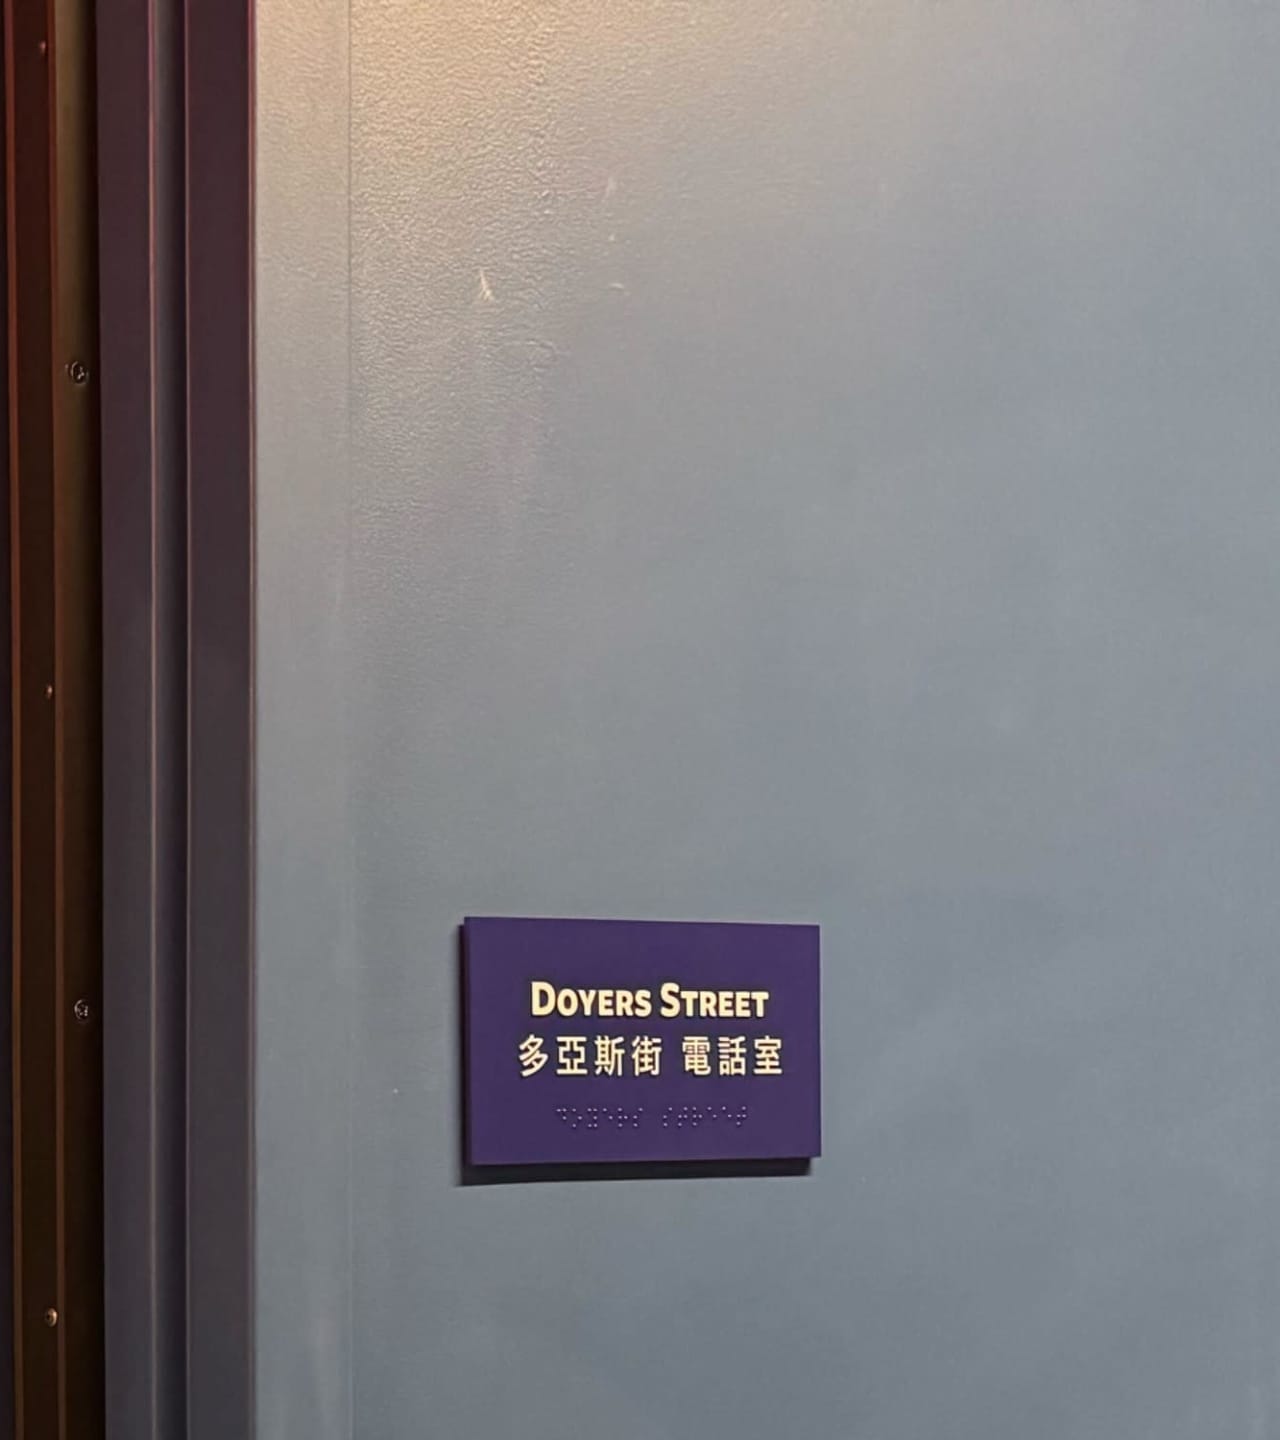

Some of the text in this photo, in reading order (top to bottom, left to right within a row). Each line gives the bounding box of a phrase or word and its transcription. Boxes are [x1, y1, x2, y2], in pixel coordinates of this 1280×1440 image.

[531, 981, 769, 1018] DOYERS STREET
[518, 1034, 783, 1077] 多亞斯街 電話室
